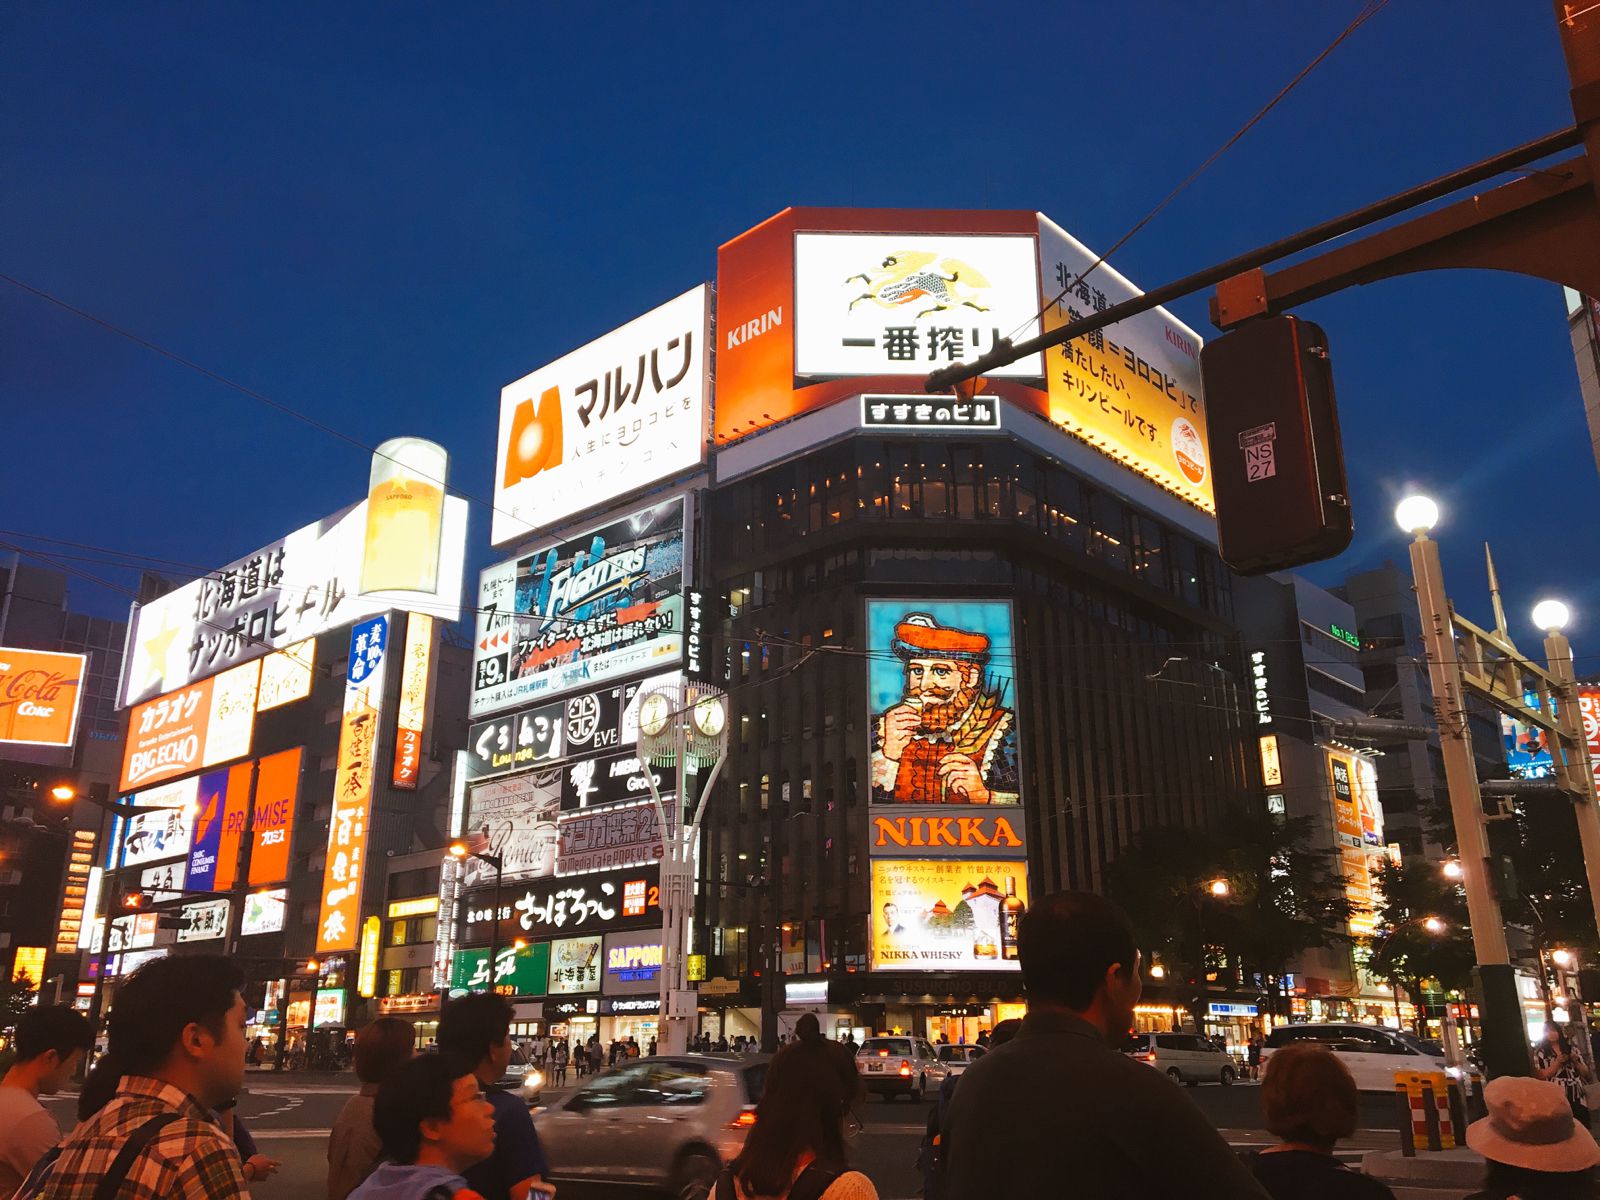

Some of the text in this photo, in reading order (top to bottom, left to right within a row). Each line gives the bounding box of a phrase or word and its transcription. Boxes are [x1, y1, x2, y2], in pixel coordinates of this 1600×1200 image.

[727, 306, 782, 349] KIRIN
[842, 325, 999, 361] 一番搾り
[1165, 325, 1195, 360] KIRIN
[574, 330, 692, 428] マルハン
[870, 403, 991, 421] すすきのビル
[1063, 370, 1162, 449] キリンビールです。
[571, 397, 691, 461] 人生にヨロコビを
[1246, 444, 1272, 463] NS
[1250, 461, 1272, 480] 27
[194, 547, 286, 621] 北海道は
[539, 545, 648, 633] FIGHTERS
[689, 592, 702, 673] すすきのビル
[1251, 651, 1272, 724] すすきのビル
[17, 701, 55, 717] Coke
[138, 690, 202, 734] カラオケ
[400, 731, 415, 778] カラオケ
[476, 715, 549, 761] くろねこ
[593, 728, 618, 748] EVE
[128, 734, 198, 782] BIG ECHO
[492, 748, 534, 768] Lounge
[227, 799, 289, 836] PRMISE
[873, 816, 1023, 847] NIKKA
[261, 829, 285, 846] プロミス
[613, 846, 649, 865] POPEYE
[467, 907, 513, 923] 北の味行
[514, 882, 616, 931] さっぽろっこ
[880, 951, 963, 960] NIKKA WHISKY
